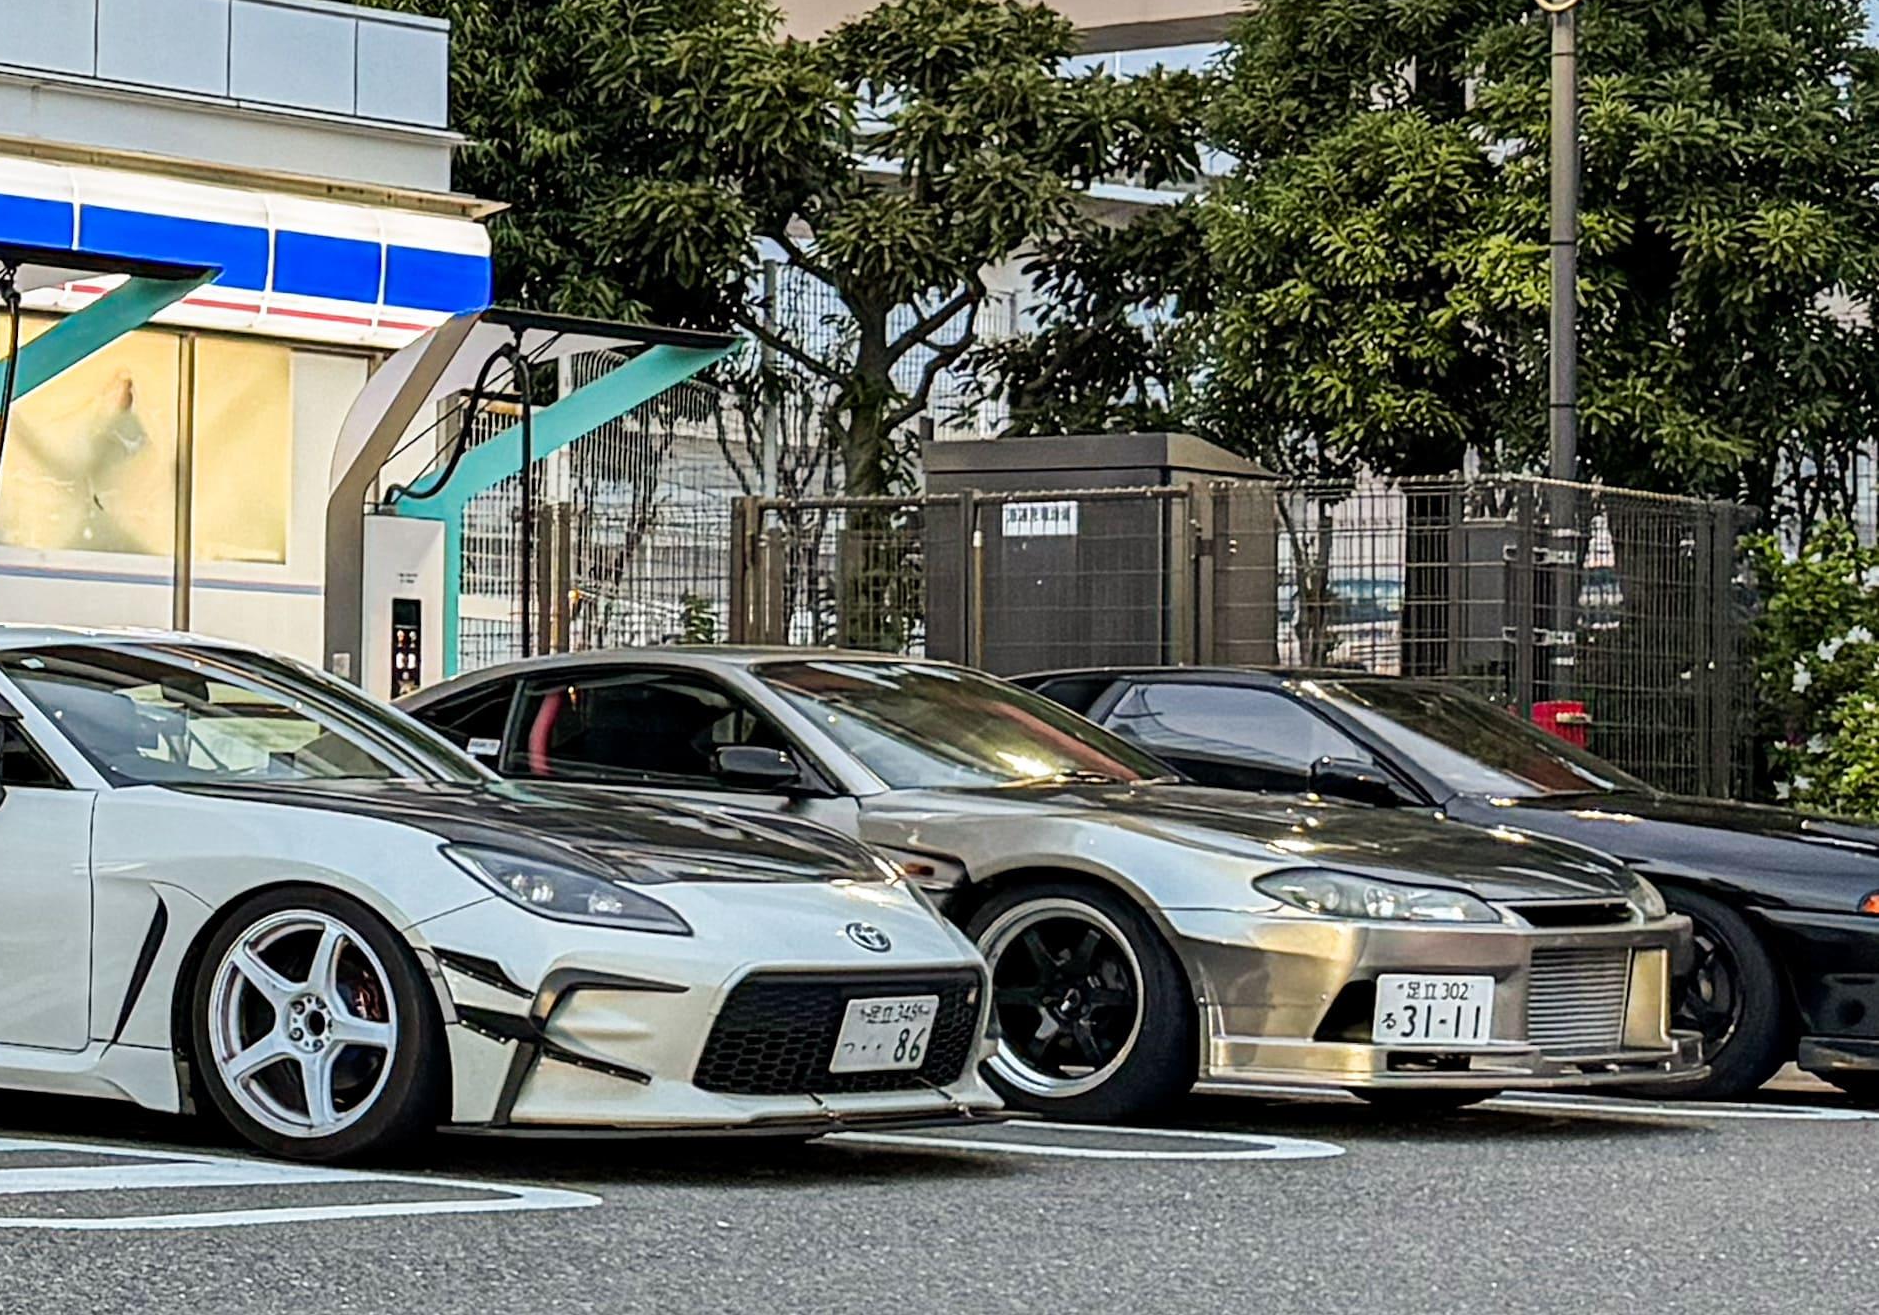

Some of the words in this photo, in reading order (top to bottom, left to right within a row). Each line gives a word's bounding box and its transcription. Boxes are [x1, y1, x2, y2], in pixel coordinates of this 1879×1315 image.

[1406, 980, 1437, 1000] 足立
[1441, 982, 1469, 1000] 302
[1400, 1004, 1481, 1039] 31-11
[894, 1026, 926, 1062] 86
